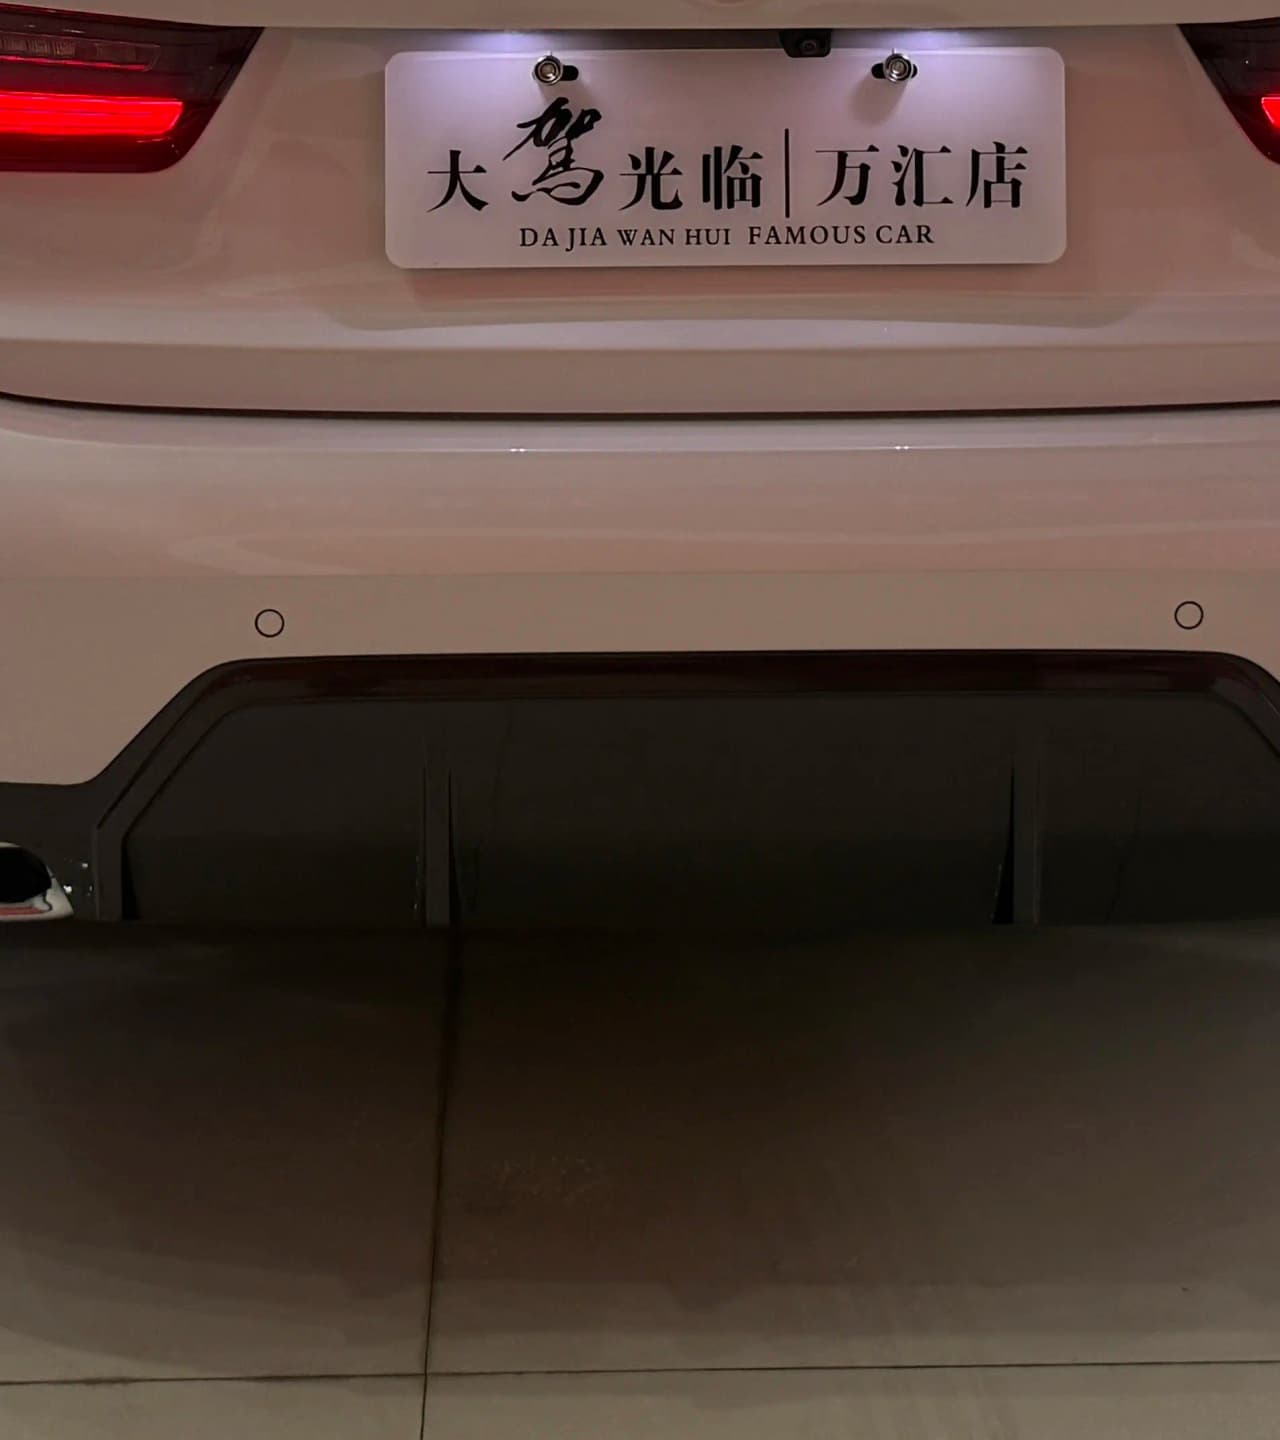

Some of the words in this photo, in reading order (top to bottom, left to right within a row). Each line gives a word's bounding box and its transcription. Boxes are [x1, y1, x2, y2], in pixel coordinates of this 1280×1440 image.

[426, 96, 764, 213] 大驾光临
[814, 140, 1030, 211] 万汇店
[519, 226, 559, 247] DA
[565, 226, 608, 252] JIA
[617, 227, 676, 246] WAN
[685, 227, 731, 246] HUI
[748, 224, 867, 245] FAMOUS
[875, 224, 935, 245] CAR
